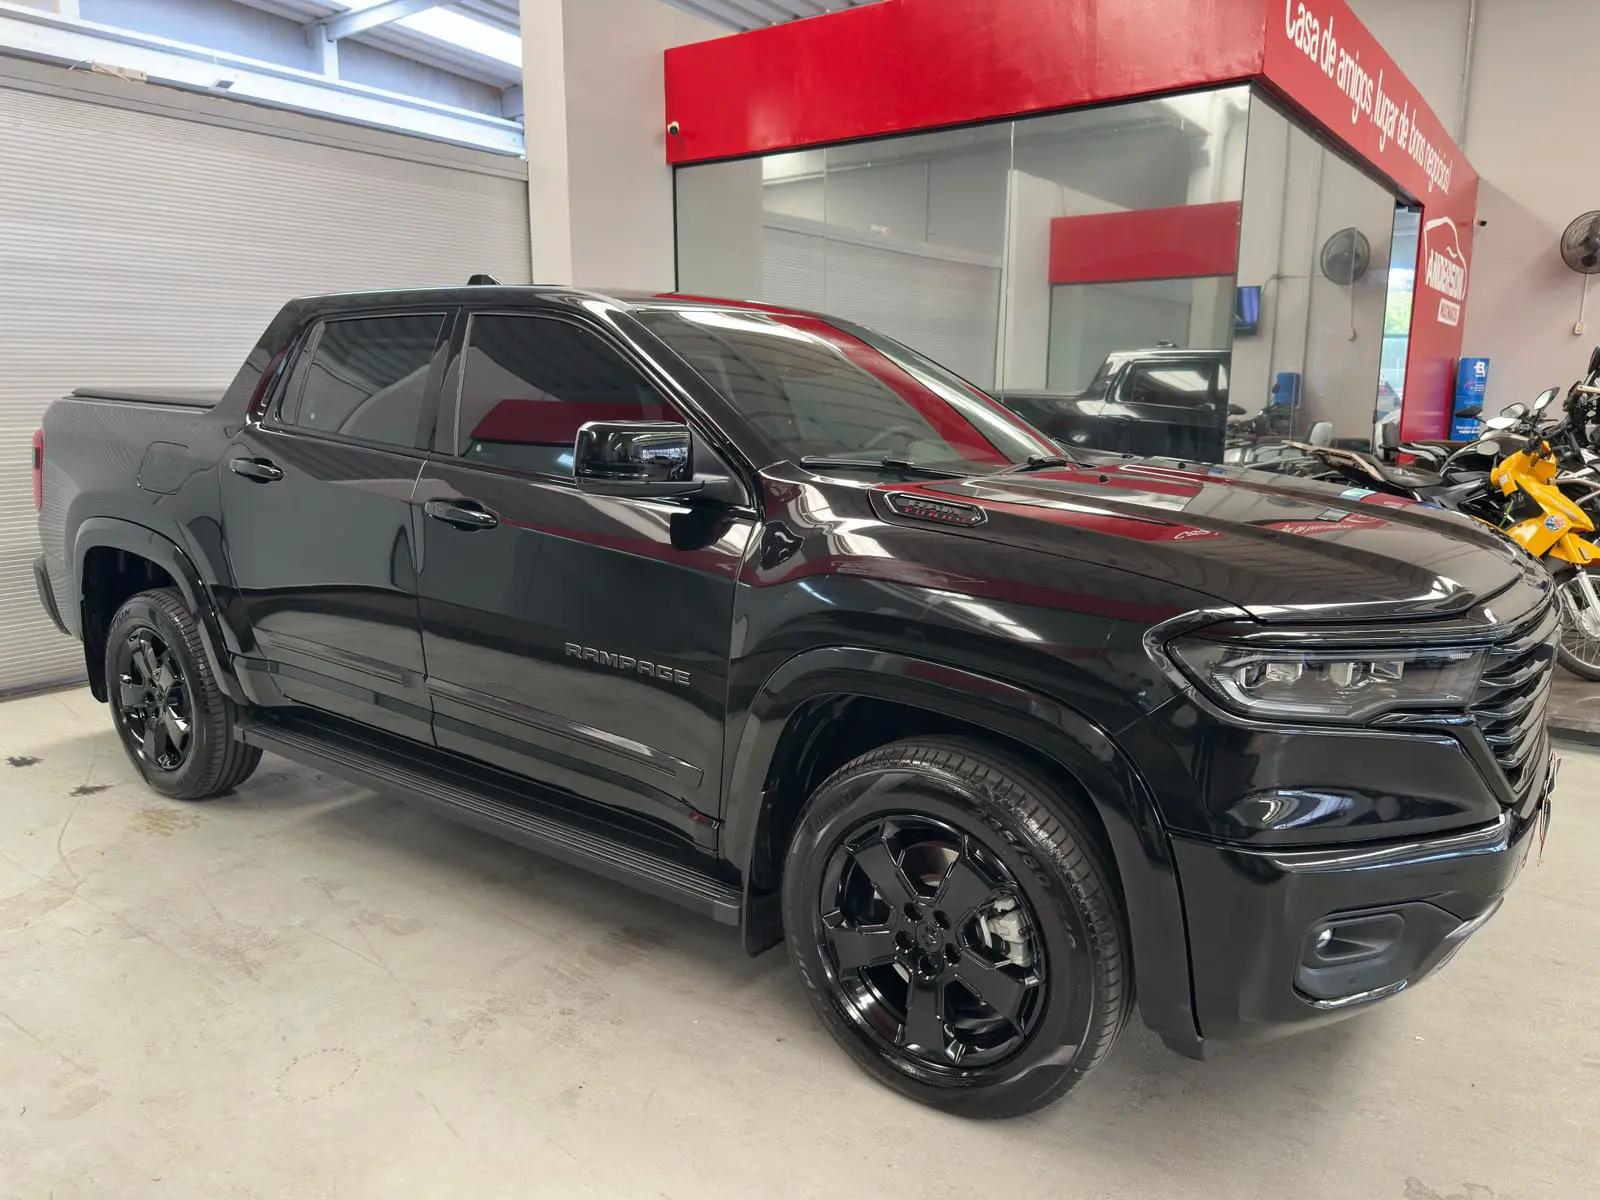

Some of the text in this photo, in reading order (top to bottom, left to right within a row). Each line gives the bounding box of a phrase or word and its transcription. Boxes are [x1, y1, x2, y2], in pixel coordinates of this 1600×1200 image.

[1320, 16, 1337, 79] de
[1336, 51, 1374, 124] amigos,
[1373, 68, 1399, 152] lugar
[1397, 100, 1408, 149] de
[1408, 108, 1426, 167] bons
[564, 642, 692, 686] RAMPAGE
